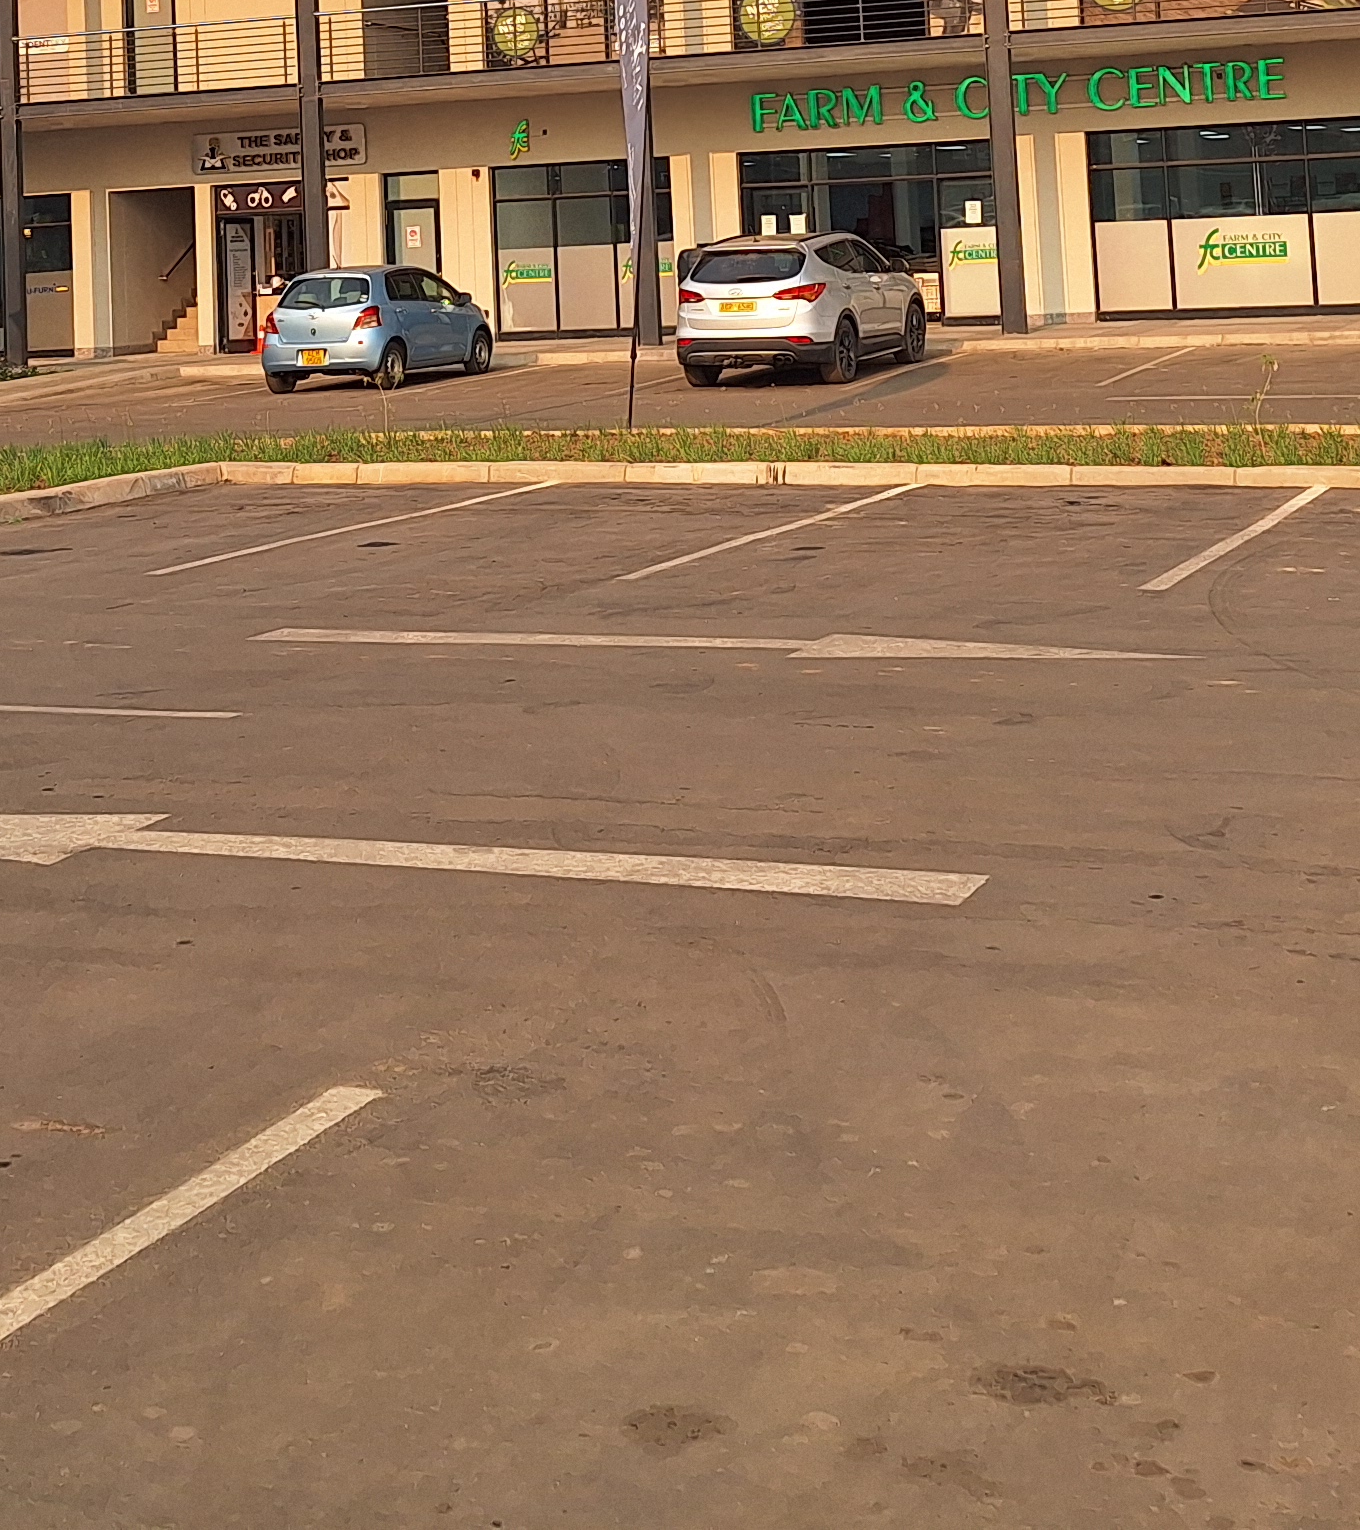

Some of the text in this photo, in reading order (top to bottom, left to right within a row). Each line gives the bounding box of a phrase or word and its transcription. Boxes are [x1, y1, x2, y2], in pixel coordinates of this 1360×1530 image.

[750, 57, 1288, 133] FARM & CTY CENTRE
[237, 129, 353, 149] THE SAFY &
[232, 147, 360, 168] SECURIT HOP
[1222, 232, 1284, 243] FARM & CITY
[965, 249, 998, 260] CENTR
[1224, 242, 1285, 258] CENTRE
